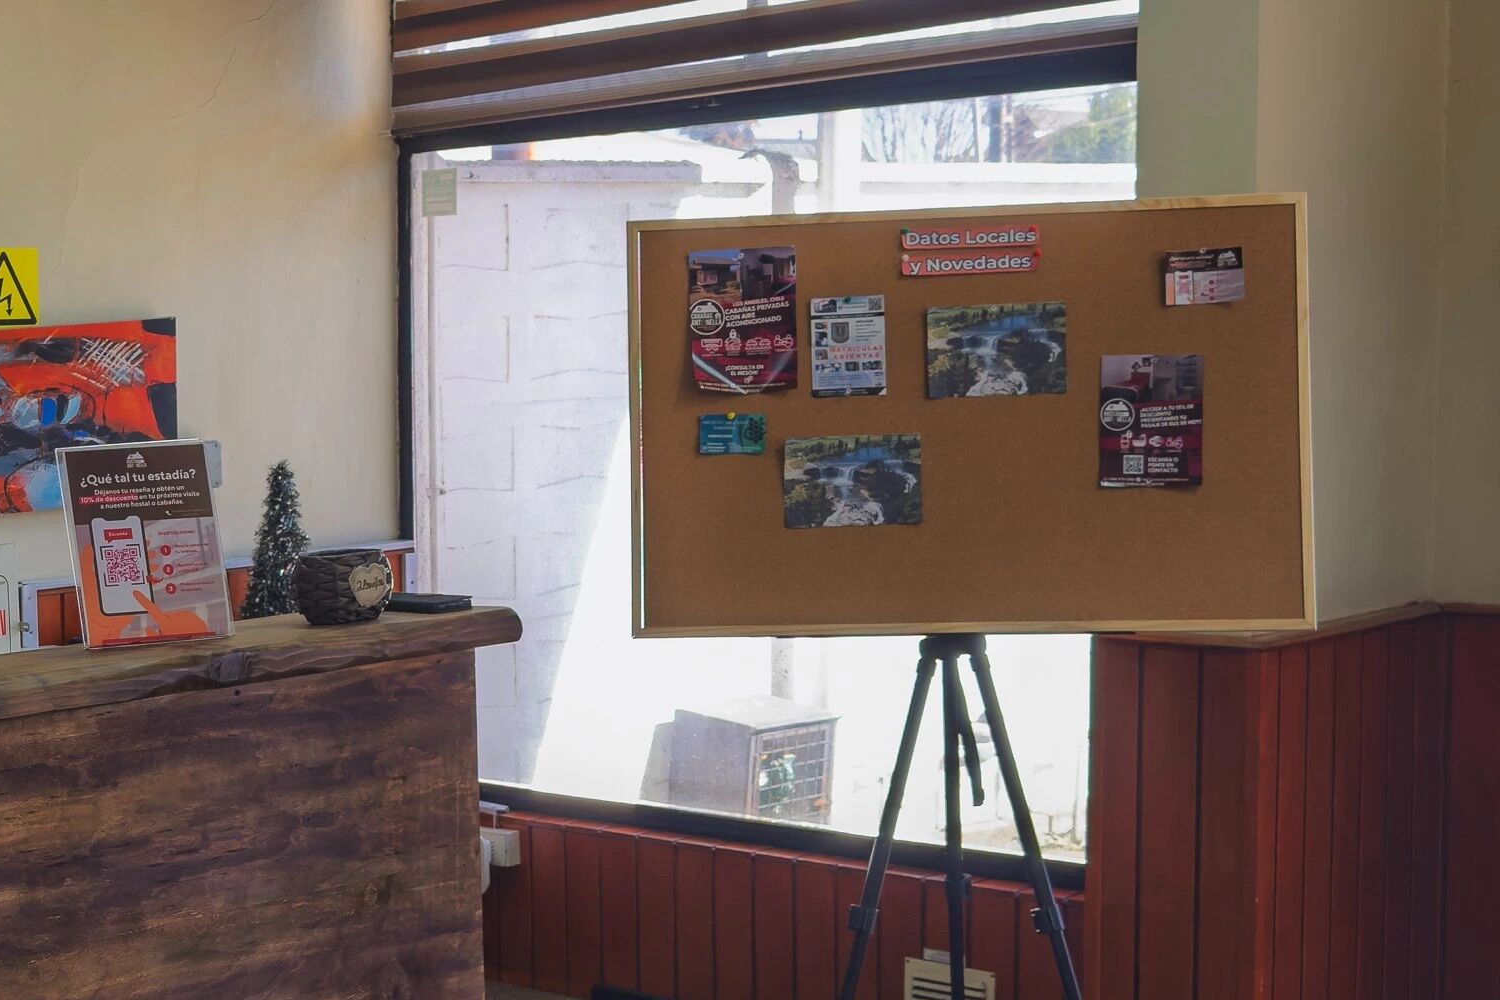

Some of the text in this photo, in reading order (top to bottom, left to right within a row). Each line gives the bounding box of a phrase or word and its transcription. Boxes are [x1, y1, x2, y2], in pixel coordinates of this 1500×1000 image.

[906, 229, 1037, 245] Datos Locales
[910, 254, 1031, 275] y Novedades
[757, 301, 789, 311] PRIVADAS
[726, 315, 782, 327] ACONDICIONADO
[80, 469, 196, 488] ¿Qué tal tu estadía?
[156, 492, 182, 500] próxima
